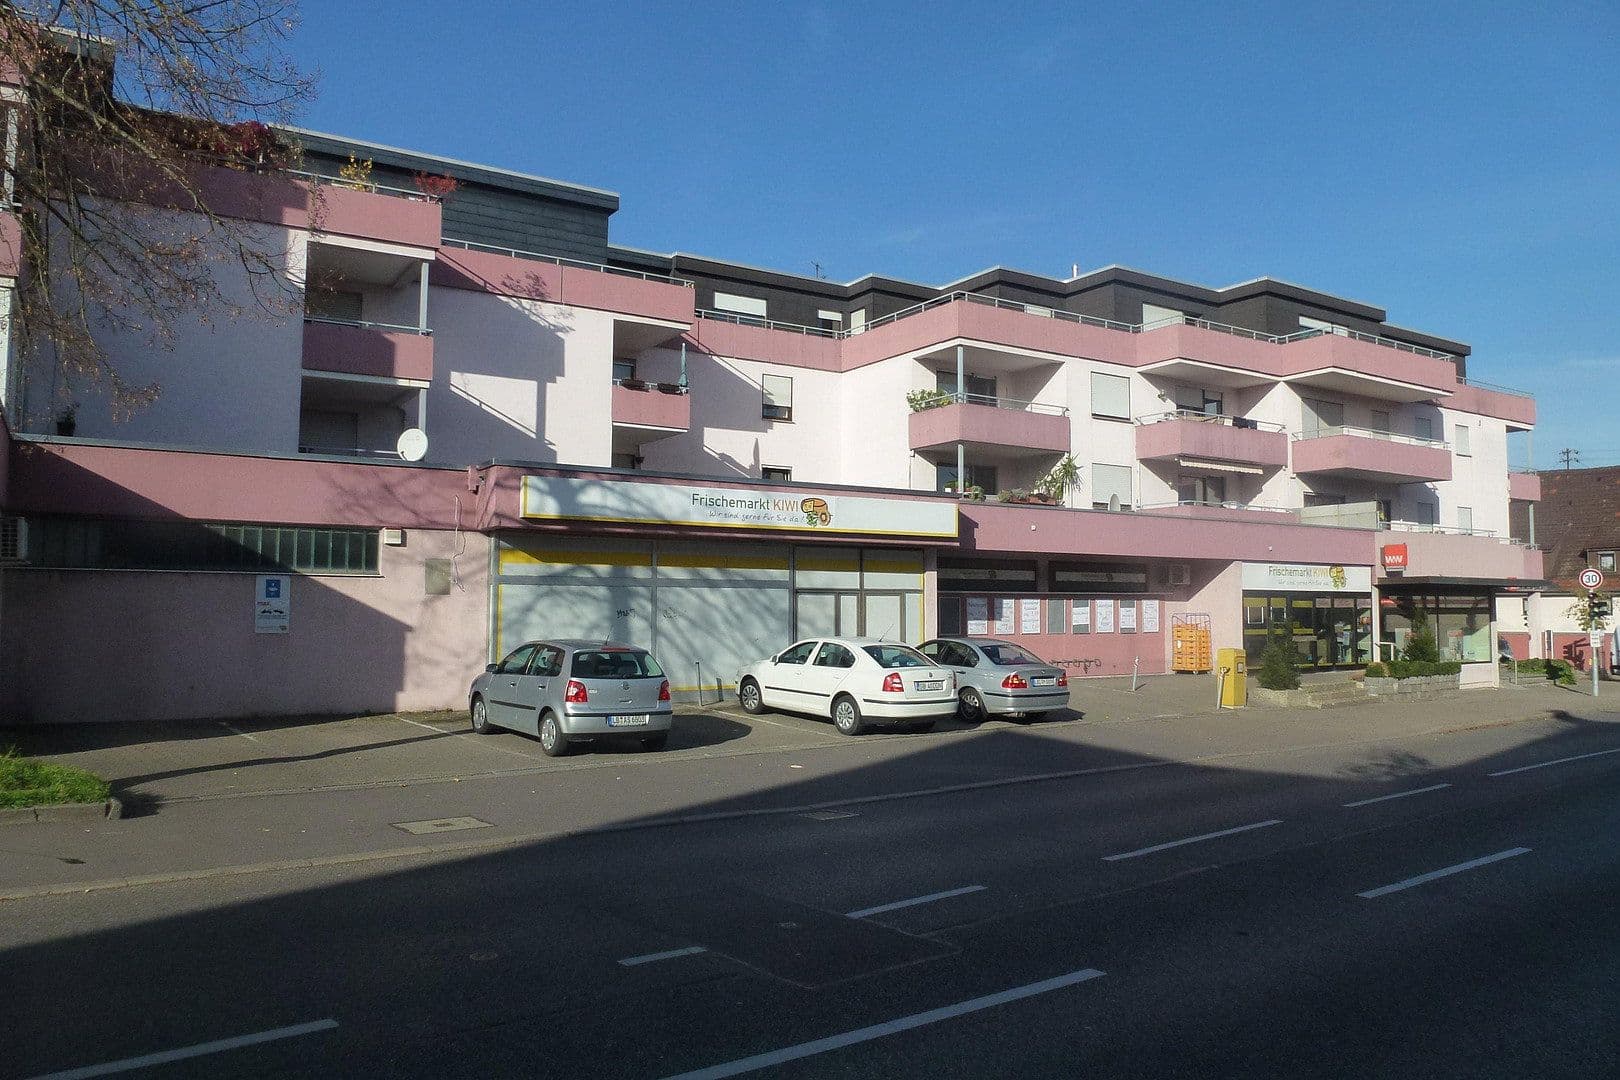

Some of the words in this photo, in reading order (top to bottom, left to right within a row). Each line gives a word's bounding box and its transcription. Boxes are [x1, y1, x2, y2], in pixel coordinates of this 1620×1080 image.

[692, 493, 770, 510] Frischemarkt
[773, 498, 799, 512] KIWI
[1268, 565, 1312, 578] Frischemarkt
[1584, 574, 1597, 583] 30
